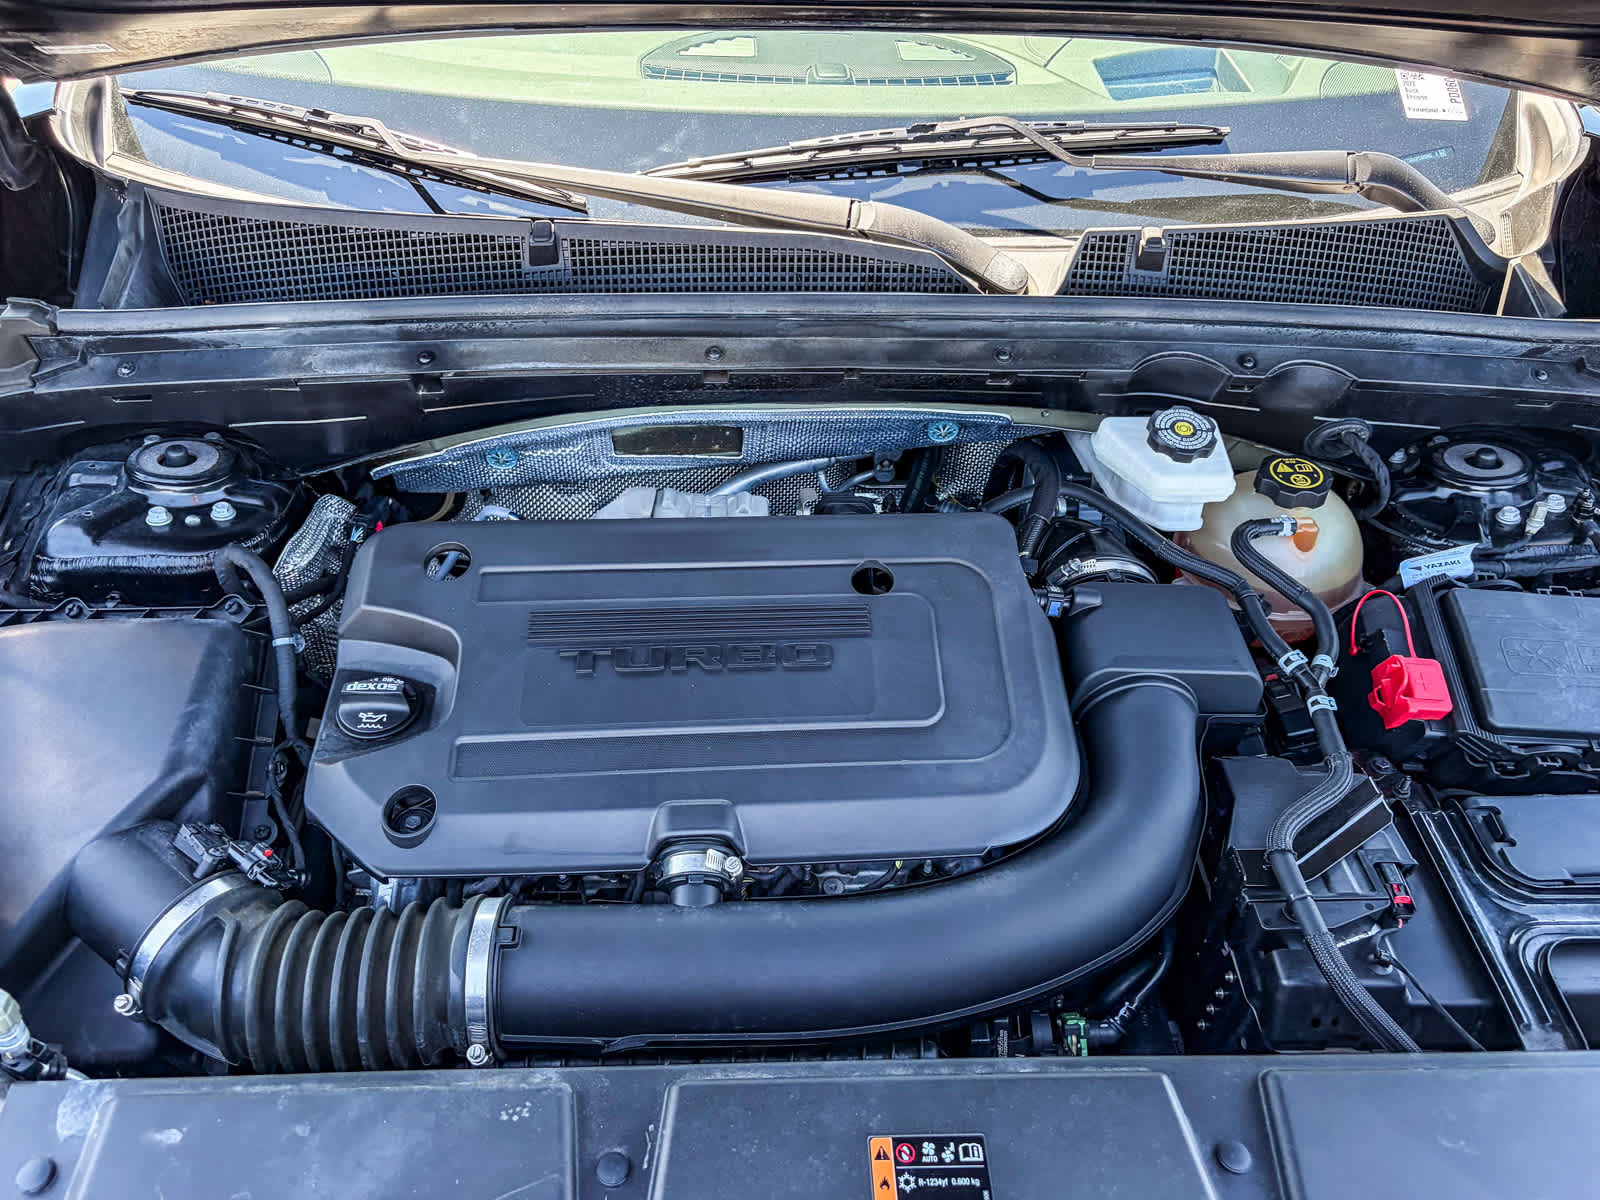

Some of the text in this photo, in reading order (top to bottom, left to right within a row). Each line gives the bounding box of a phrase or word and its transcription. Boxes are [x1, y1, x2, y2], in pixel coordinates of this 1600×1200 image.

[1423, 559, 1461, 569] YAZAKI
[559, 641, 835, 676] TURBO
[346, 681, 398, 691] dexos
[922, 1155, 938, 1163] AUTO
[918, 1177, 948, 1187] R-1234yf
[971, 1177, 980, 1187] kg
